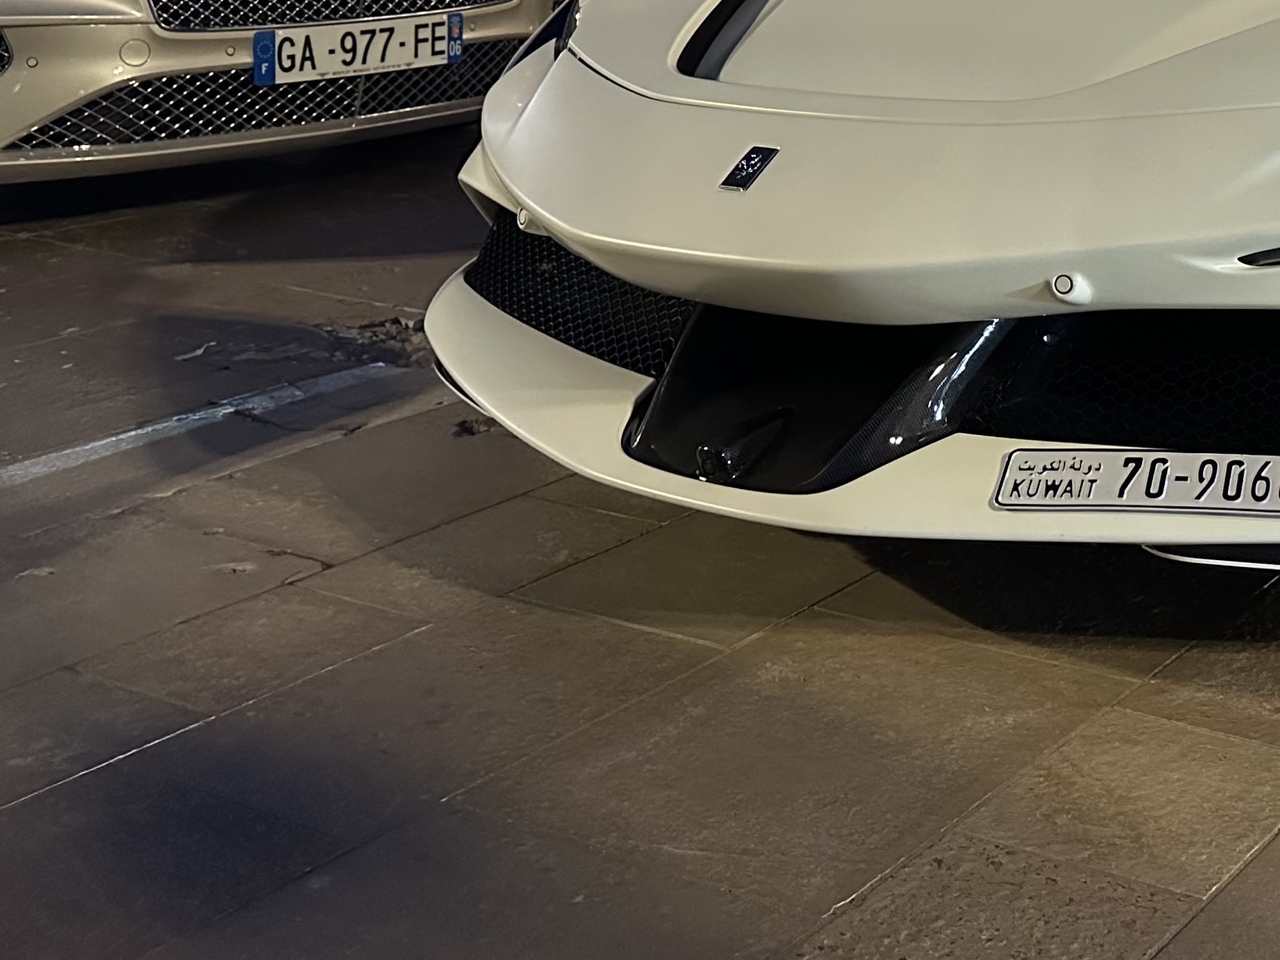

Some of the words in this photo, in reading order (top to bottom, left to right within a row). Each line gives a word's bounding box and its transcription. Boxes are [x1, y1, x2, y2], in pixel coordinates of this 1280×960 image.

[261, 63, 269, 75] F
[449, 40, 462, 56] 06
[1017, 457, 1068, 478] الكويت
[1070, 456, 1103, 476] دولة
[1009, 478, 1099, 500] KUWAIT
